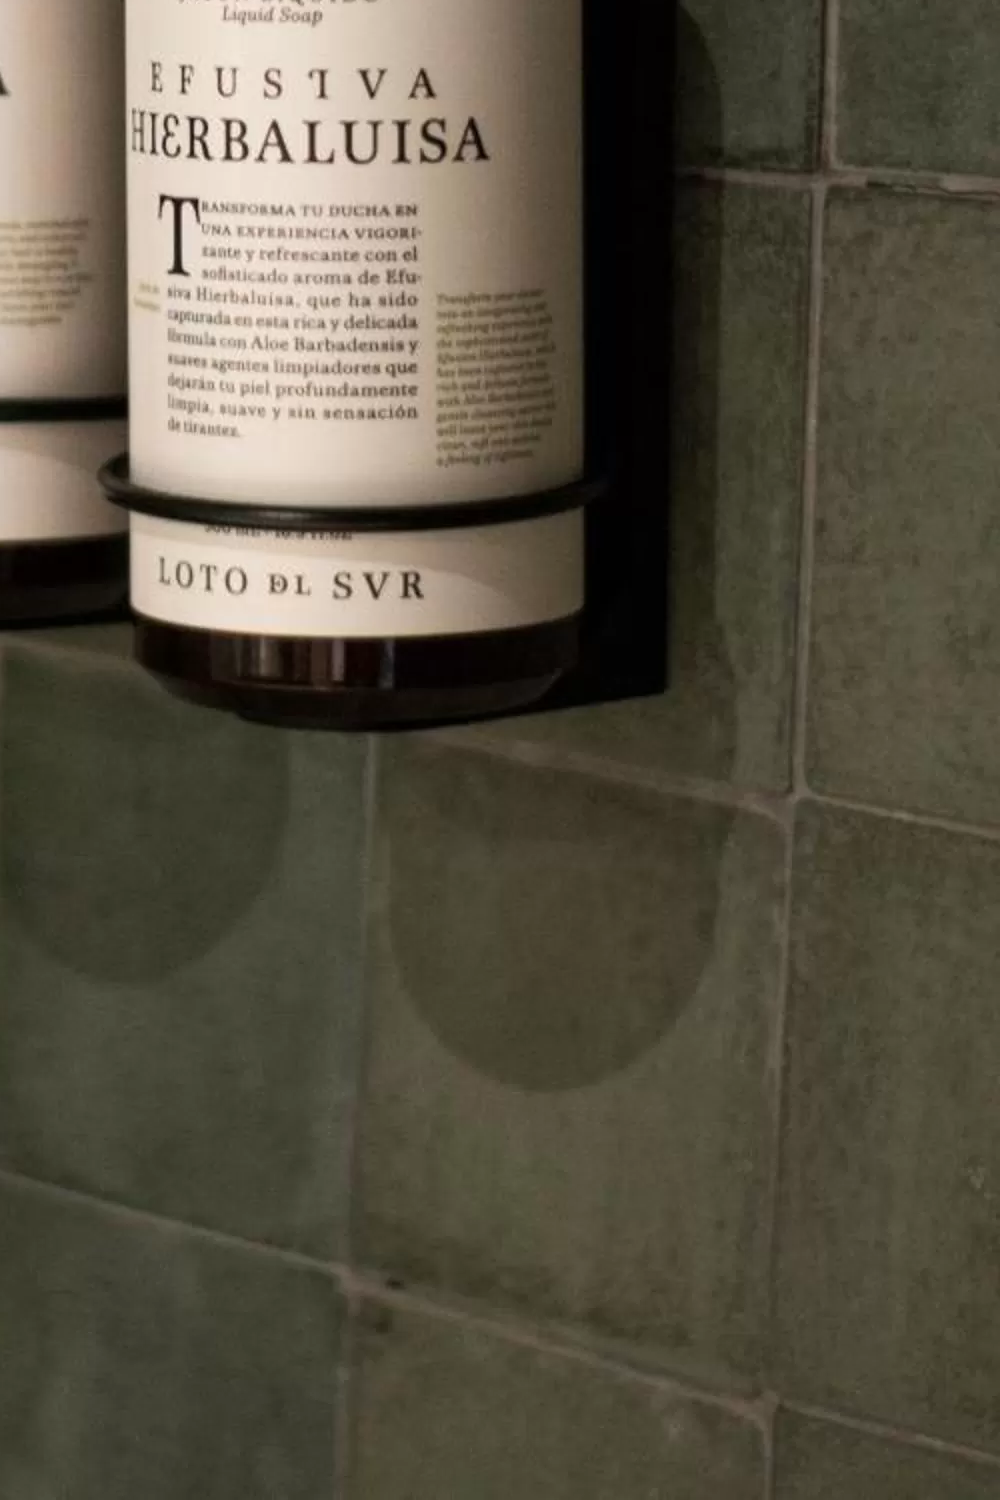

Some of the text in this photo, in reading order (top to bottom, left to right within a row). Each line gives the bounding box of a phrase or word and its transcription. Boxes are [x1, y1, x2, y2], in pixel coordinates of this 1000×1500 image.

[222, 5, 323, 27] Liquid Soap
[131, 108, 491, 165] HIERBALUISA
[301, 201, 322, 216] TU
[329, 204, 389, 216] DUCHA
[395, 204, 417, 216] EN
[201, 223, 422, 240] UNA EXPERIENCIA VIGORI-
[202, 246, 418, 262] zante y refrescante con el
[202, 267, 422, 285] sofisticado aroma de Efu-
[167, 285, 191, 301] siva
[197, 287, 300, 308] Hierbaluisa,
[306, 293, 341, 314] que
[348, 291, 371, 308] ha
[378, 291, 419, 308] sido
[167, 308, 418, 333] capturada en esta rica y delicada
[220, 335, 247, 349] con
[250, 335, 289, 351] Aloe
[294, 336, 405, 353] Barbadensis
[408, 340, 418, 356] y
[211, 357, 269, 374] agentes
[273, 357, 381, 378] limpiadores
[385, 362, 418, 378] que
[219, 379, 235, 393] tu
[240, 379, 271, 398] piel
[275, 380, 419, 399] profundamente
[167, 393, 418, 421] limpia, suave y sin sensación
[167, 418, 181, 432] de
[159, 556, 249, 596] LOTO
[331, 571, 425, 600] SVR
